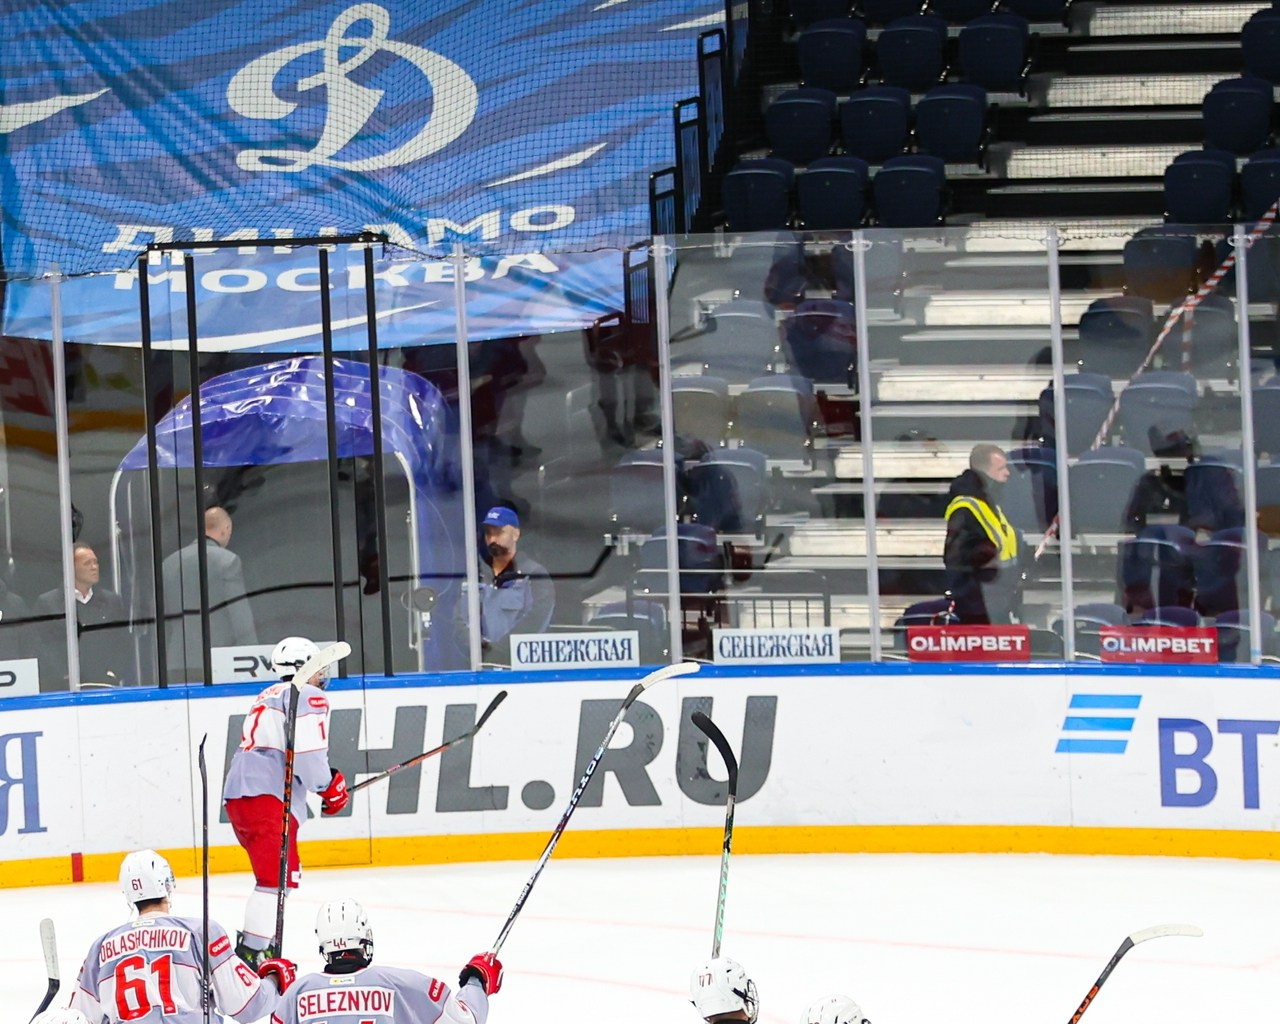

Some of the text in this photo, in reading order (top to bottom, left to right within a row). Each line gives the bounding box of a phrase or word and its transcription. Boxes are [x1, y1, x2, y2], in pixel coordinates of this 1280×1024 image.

[113, 253, 559, 293] МОСКВА
[516, 638, 633, 664] СЕНЕЖСКАЯ
[719, 633, 834, 659] СЕНЕЖСКАЯ
[220, 695, 778, 823] HL.RU
[1158, 717, 1280, 809] ВТ
[131, 878, 143, 891] 61
[100, 929, 188, 963] OBLASHCHIKOV
[333, 938, 347, 949] 44
[115, 955, 177, 1021] 61
[234, 963, 258, 987] 61
[299, 990, 391, 1017] SELEZNYOV
